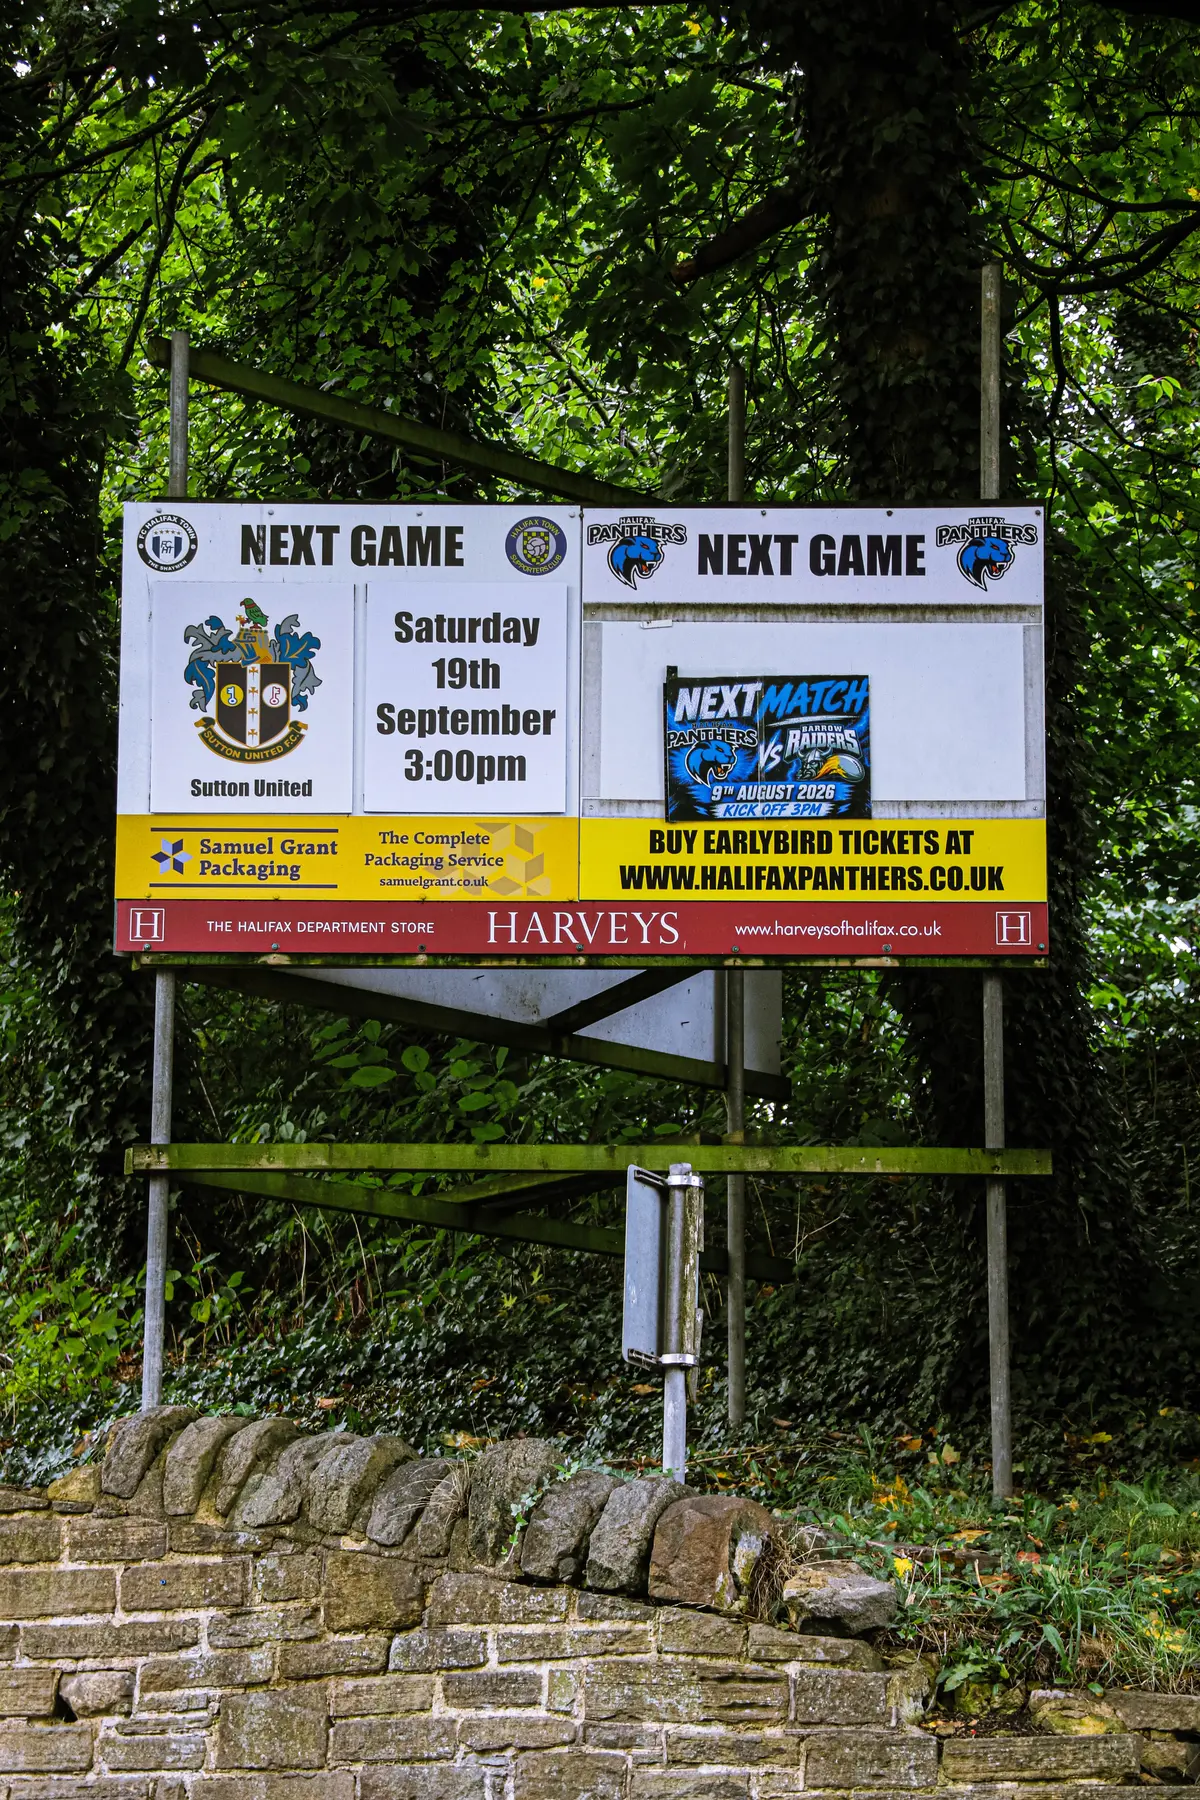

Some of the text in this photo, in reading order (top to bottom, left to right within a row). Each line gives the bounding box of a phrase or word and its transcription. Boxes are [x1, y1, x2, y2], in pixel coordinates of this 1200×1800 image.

[139, 515, 197, 540] FC HALIFAX TOWN
[511, 519, 560, 539] HALIFAX TOWN
[969, 517, 1005, 525] HALIFAX
[241, 524, 464, 567] NEXT GAME
[587, 524, 687, 546] PANTHERS
[936, 524, 1038, 547] PANTHERS
[148, 559, 188, 571] THE SHAYMEN
[547, 554, 562, 570] CLUB
[698, 533, 926, 577] NEXT GAME
[394, 611, 540, 647] Saturday
[431, 657, 500, 690] 19th
[674, 678, 869, 722] NEXT MATCH
[376, 703, 556, 739] September
[802, 724, 843, 733] BARROW
[203, 731, 241, 759] SUTTON
[244, 745, 285, 760] UNITED
[667, 728, 758, 749] PANTHERS
[785, 729, 861, 758] RAIDERS
[404, 749, 526, 785] 3:00pm
[191, 779, 313, 797] Sutton United
[711, 784, 836, 801] 9TH AUGUST 2026
[723, 802, 823, 817] KICK OFF 3PM
[200, 837, 338, 856] Samuel Grant
[378, 830, 490, 849] The Complete
[649, 829, 975, 856] BUY EARLYBIRD TICKETS AT
[199, 858, 301, 881] Packaging
[364, 852, 504, 870] Packaging Service
[379, 876, 489, 889] samuelgrant.co.uk
[619, 865, 1005, 892] WWW.HALIFAXPANTHERS.CO.UK
[206, 921, 435, 934] THE HALIFAX DEPARTMENT STORE
[486, 911, 679, 945] HARVEYS
[735, 920, 942, 939] www.harveysofhalifax.co.uk
